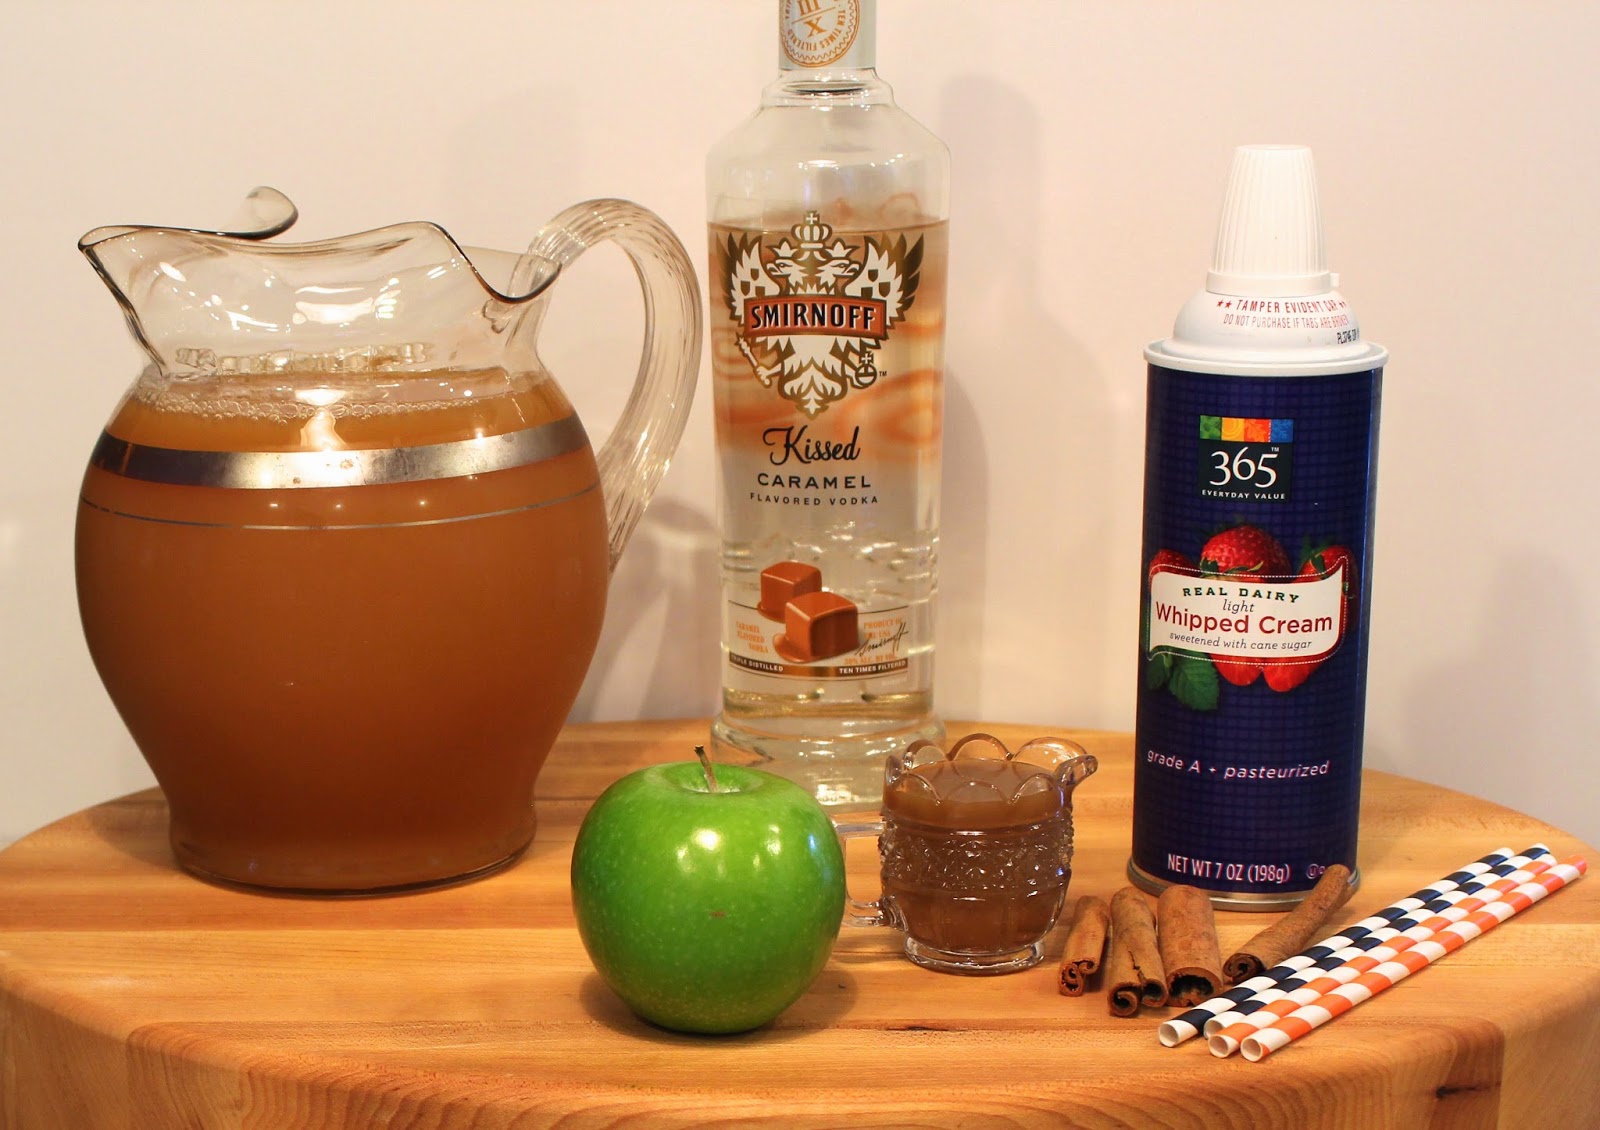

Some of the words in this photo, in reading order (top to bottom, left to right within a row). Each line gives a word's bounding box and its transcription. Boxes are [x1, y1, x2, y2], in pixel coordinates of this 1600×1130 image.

[803, 16, 827, 38] X
[837, 10, 846, 26] TEN
[787, 28, 817, 51] FILTERED
[820, 28, 841, 48] TIMES
[1236, 300, 1280, 313] TAMPER
[1285, 301, 1324, 313] EVIDENT
[751, 302, 876, 330] SMIRNOFF
[1223, 313, 1234, 325] DO
[1235, 315, 1250, 328] NOT
[1252, 316, 1291, 329] PURCHASE
[1293, 317, 1300, 329] IF
[1301, 317, 1319, 329] TABS
[1320, 316, 1332, 329] ARE
[762, 425, 861, 466] Kissed
[1209, 446, 1279, 488] 365
[757, 473, 871, 489] CARAMEL
[750, 492, 821, 506] FLAVORED
[829, 495, 878, 506] VODKA
[1201, 489, 1250, 499] EVERYDAY
[1182, 587, 1228, 597] REAL
[1238, 588, 1300, 604] DAIRY
[1222, 599, 1255, 615] light
[1155, 601, 1249, 634] Whipped
[1258, 615, 1333, 634] Cream
[1169, 631, 1220, 647] sweetened
[1223, 639, 1247, 650] with
[1250, 641, 1278, 650] cane
[1281, 640, 1312, 652] sugar
[748, 660, 784, 672] DISTILLED
[855, 664, 877, 673] TIMES
[878, 660, 906, 671] FILTERED
[1147, 750, 1184, 770] grade
[1188, 760, 1201, 773] A
[1224, 760, 1330, 779] pasteurized
[1167, 853, 1188, 873] NET
[1191, 860, 1212, 878] WT
[1215, 863, 1222, 878] 7
[1226, 864, 1243, 881] OZ
[1247, 864, 1291, 884] (198g)
